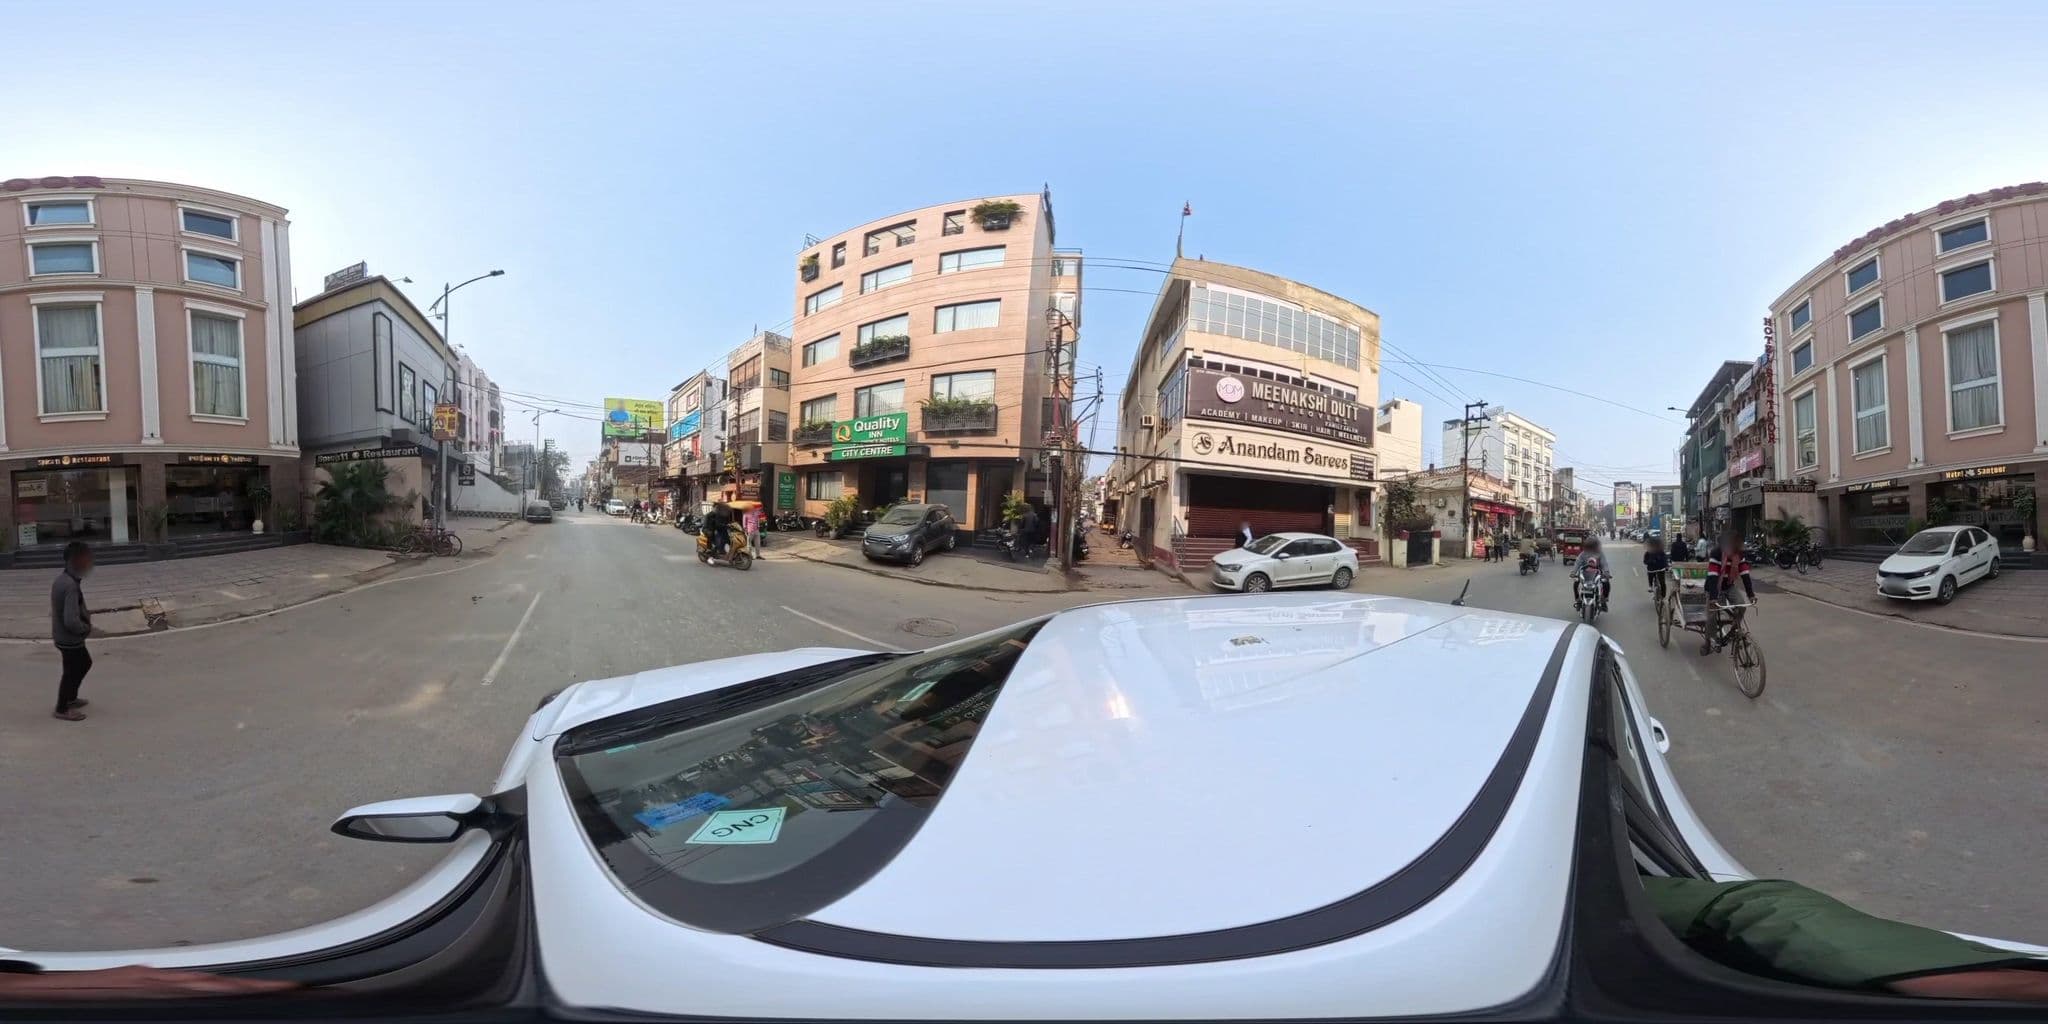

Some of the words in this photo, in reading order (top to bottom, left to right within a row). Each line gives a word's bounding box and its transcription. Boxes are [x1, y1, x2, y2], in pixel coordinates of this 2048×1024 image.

[1331, 400, 1359, 421] DUTT
[1765, 366, 1776, 444] SANTOOR
[854, 416, 900, 432] Quality
[1200, 408, 1240, 419] ACADEMY
[1251, 414, 1282, 425] MAKEUP
[1291, 421, 1308, 431] SKIN
[1315, 426, 1331, 436] HAIR
[1338, 432, 1367, 443] WELLNESS
[363, 446, 420, 459] Restaurant
[841, 448, 859, 457] CITY
[860, 446, 893, 456] CENTRE
[1217, 436, 1300, 463] Anandam
[1303, 447, 1348, 470] Sarees
[711, 814, 769, 838] CNG
